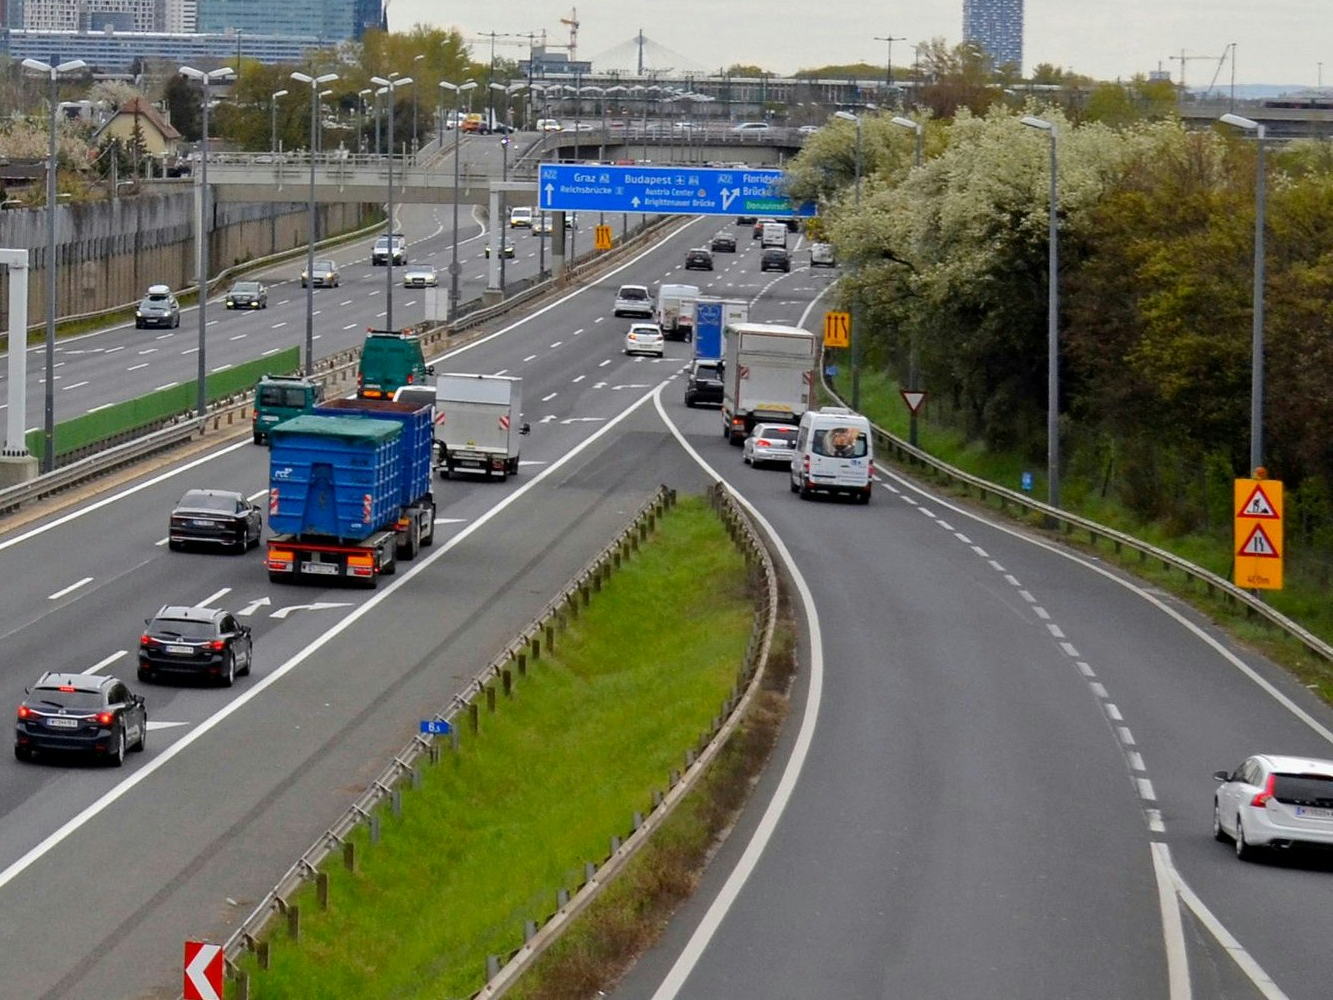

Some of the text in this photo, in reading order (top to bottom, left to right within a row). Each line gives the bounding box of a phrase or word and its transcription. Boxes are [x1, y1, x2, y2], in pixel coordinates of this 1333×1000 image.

[574, 172, 596, 183] Graz
[624, 174, 672, 186] Budapest
[560, 184, 613, 195] Reichsbrücke
[645, 187, 694, 197] Austria Center
[692, 198, 716, 208] Brücke
